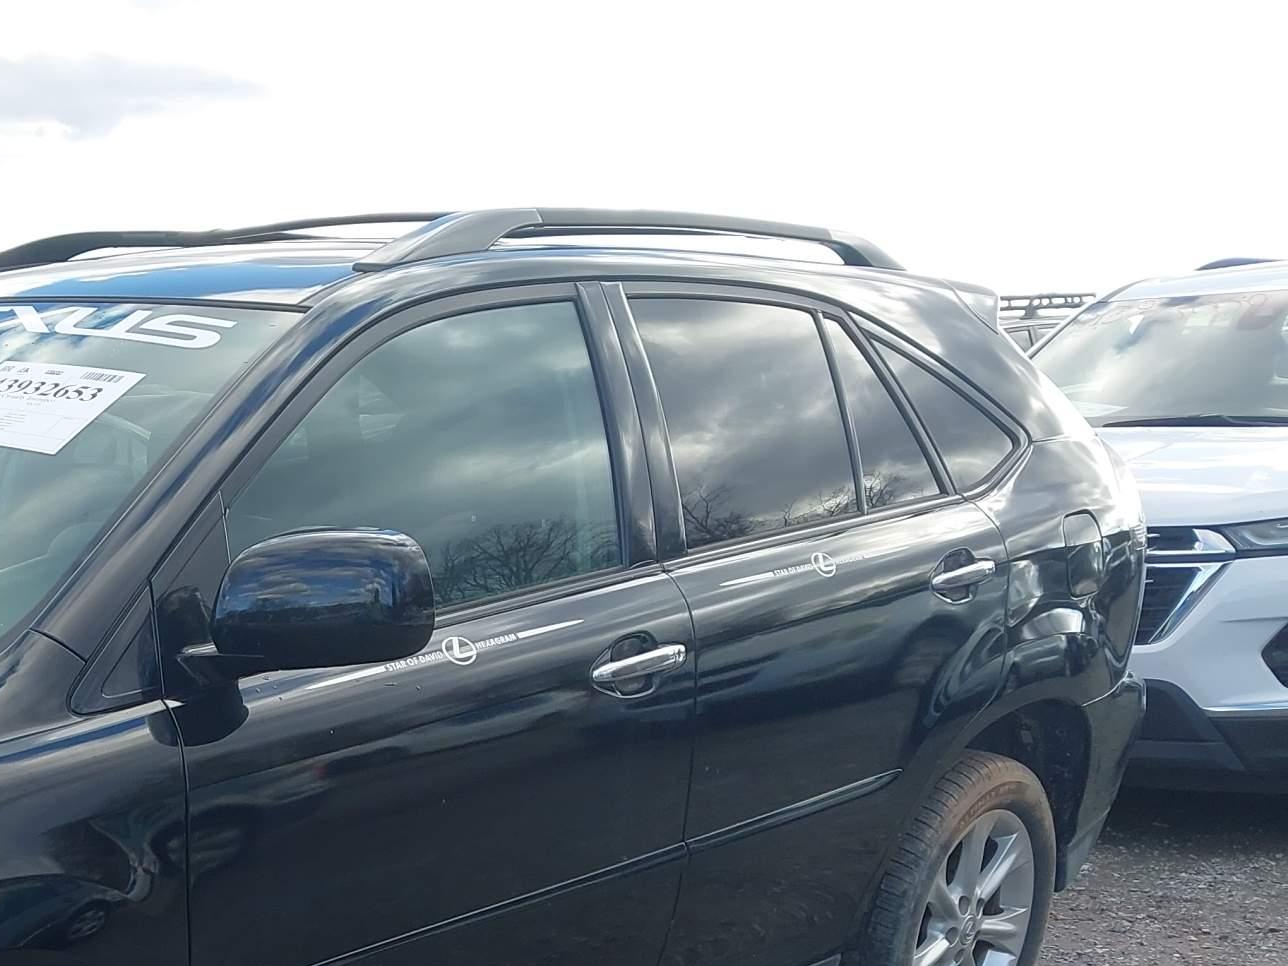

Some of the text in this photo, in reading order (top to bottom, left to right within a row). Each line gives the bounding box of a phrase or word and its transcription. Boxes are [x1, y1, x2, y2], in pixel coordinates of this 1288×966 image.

[386, 633, 518, 672] STAR OF DAVID HEXAGRAM
